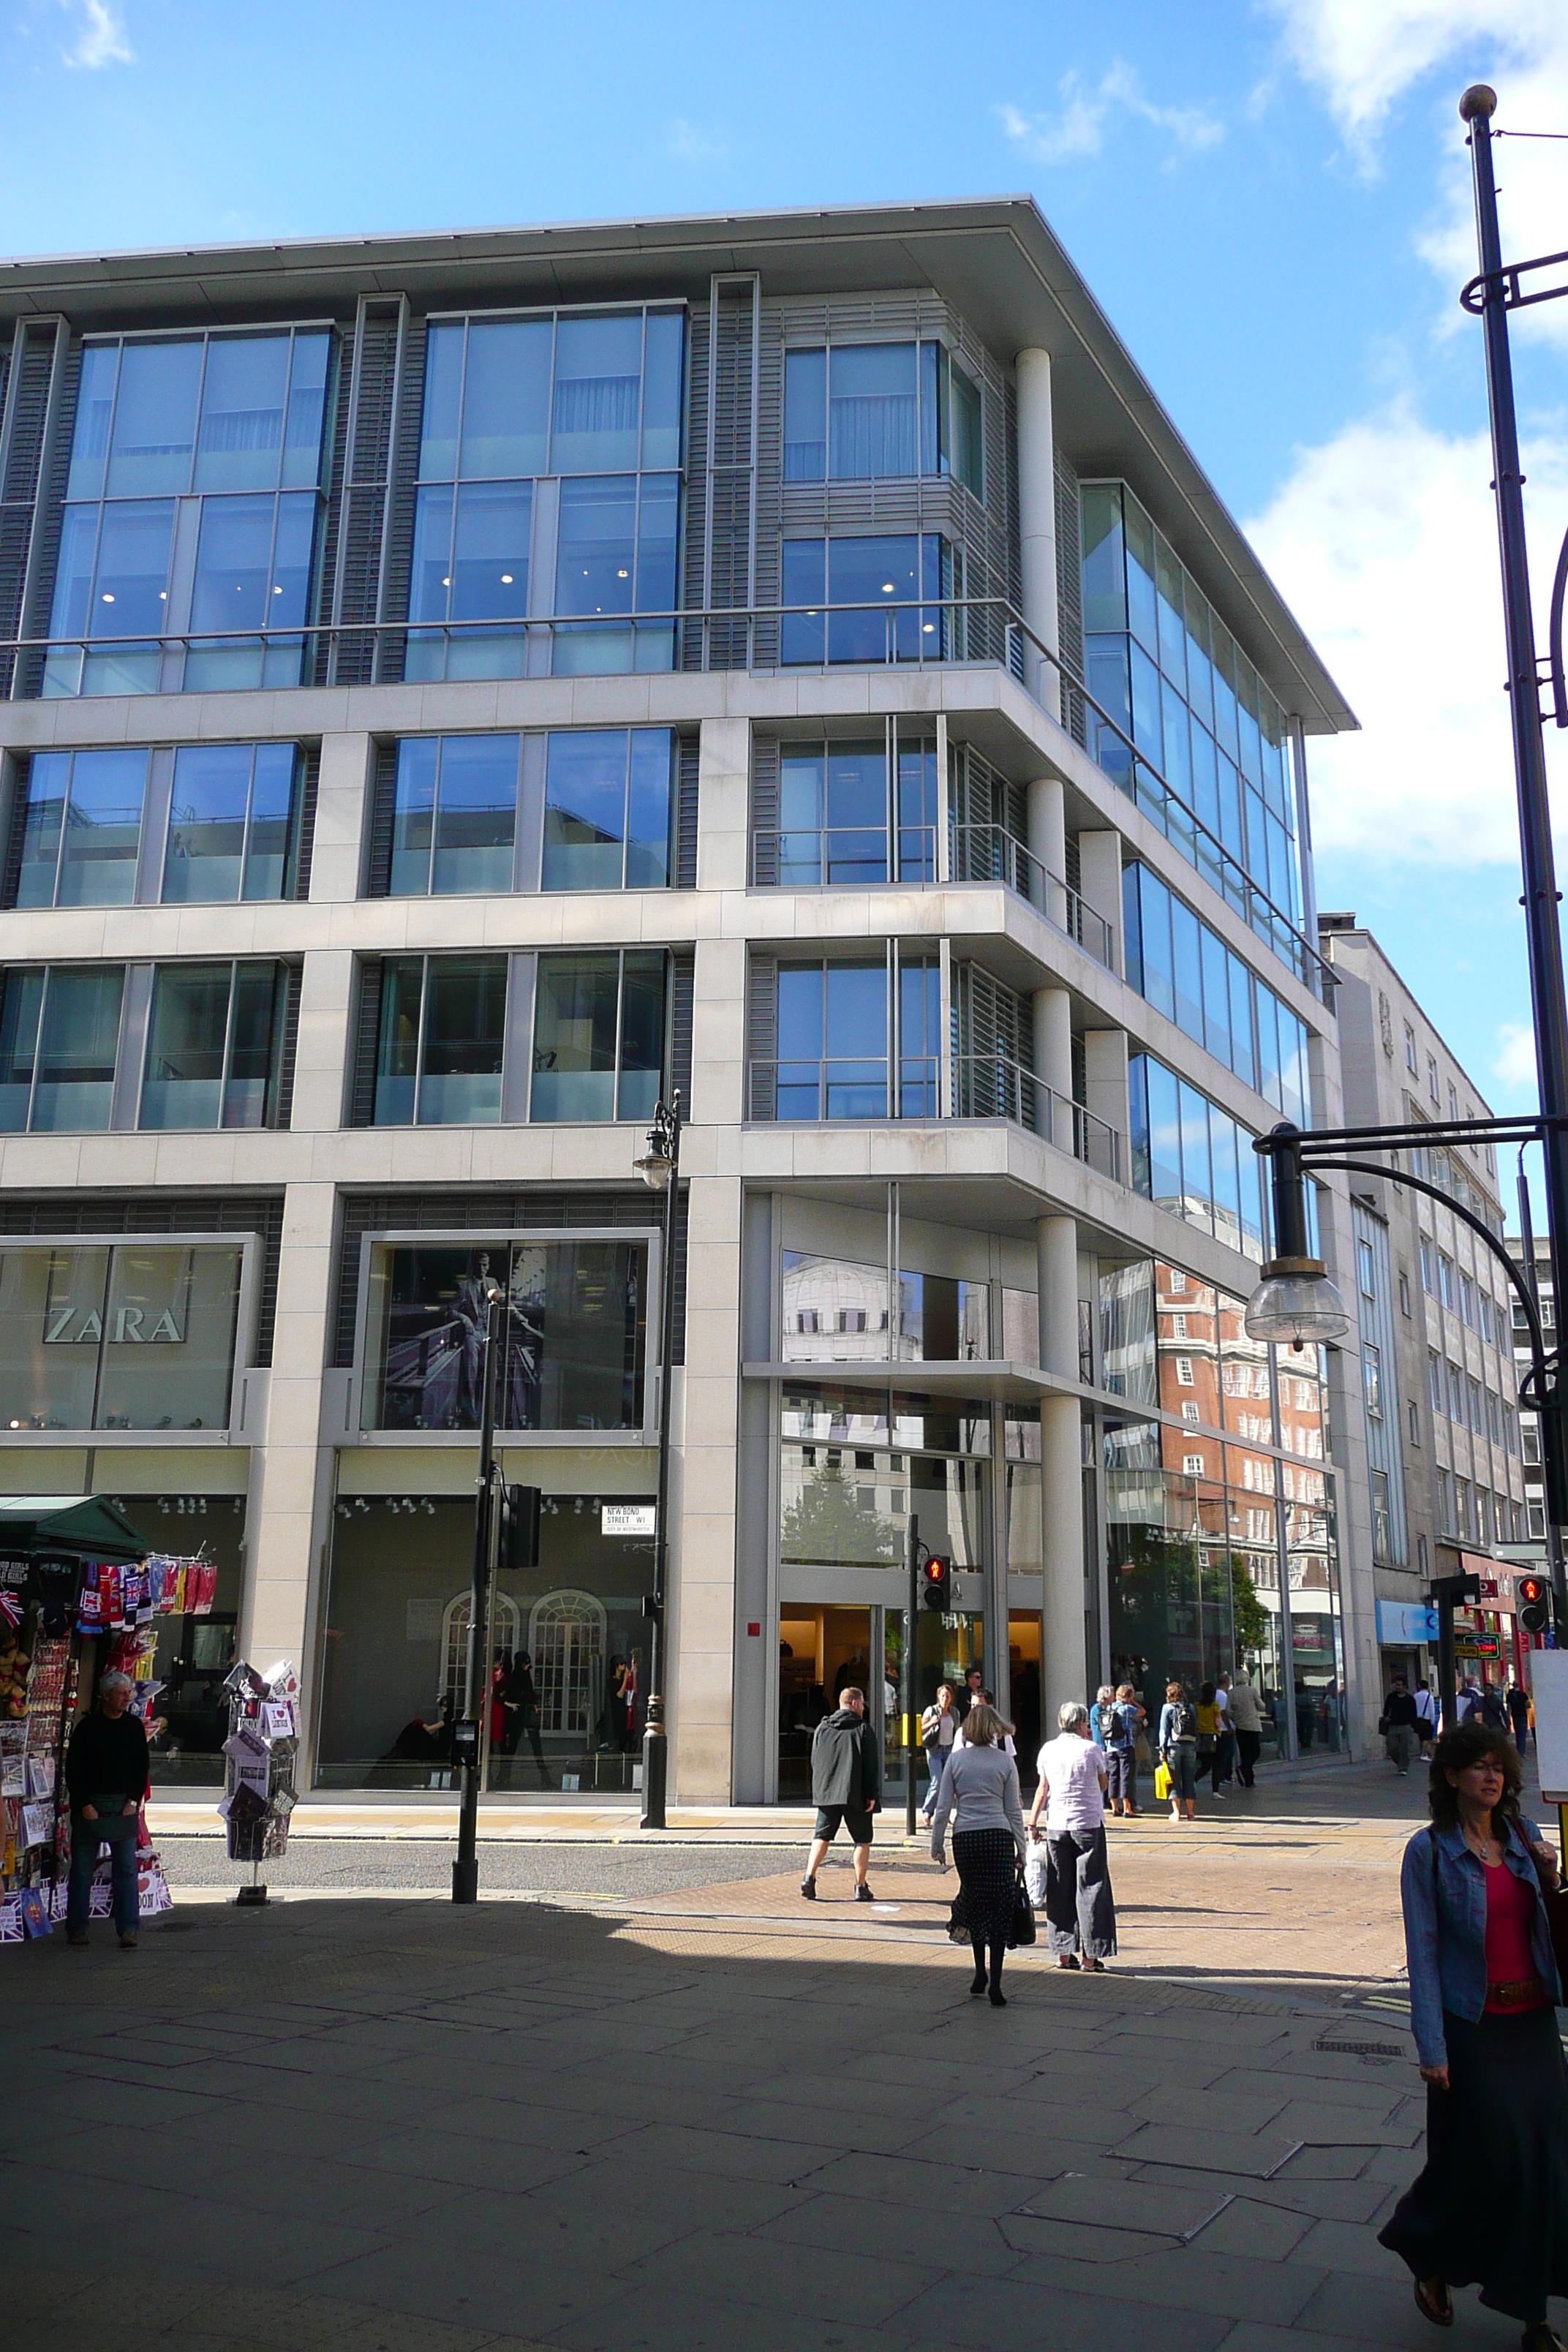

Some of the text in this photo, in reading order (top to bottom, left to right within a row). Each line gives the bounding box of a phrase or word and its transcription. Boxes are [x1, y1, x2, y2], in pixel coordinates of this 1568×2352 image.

[44, 1307, 184, 1343] ZARA
[607, 1507, 639, 1515] NEW BOND
[11, 1562, 29, 1571] GIRLS
[8, 1572, 28, 1581] GIRLS
[271, 1710, 276, 1719] I
